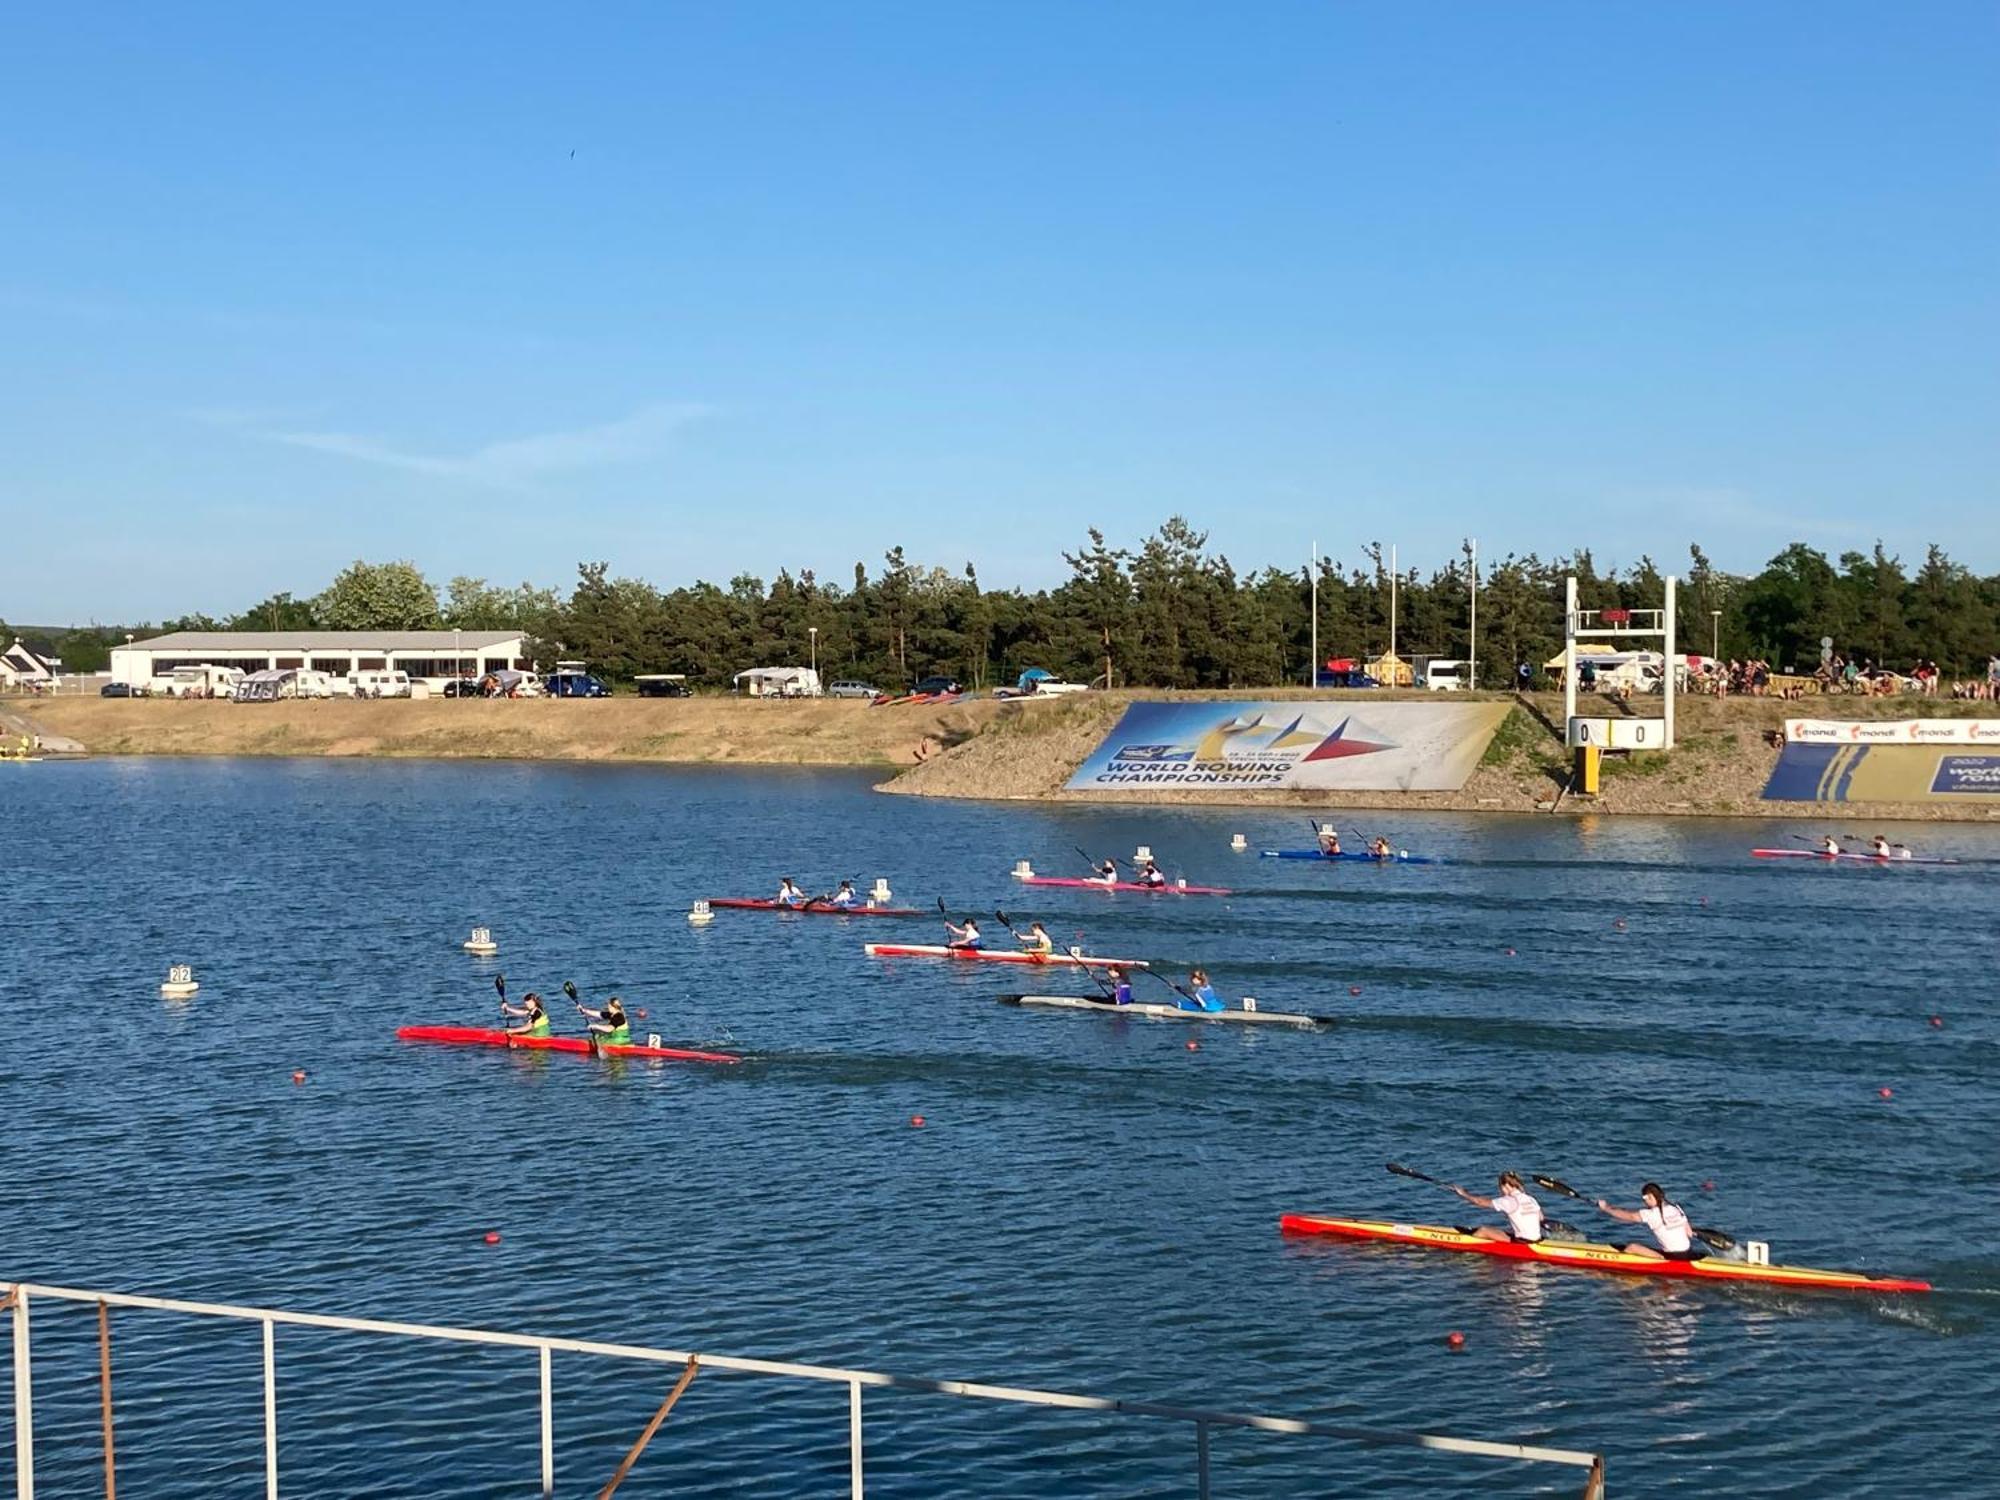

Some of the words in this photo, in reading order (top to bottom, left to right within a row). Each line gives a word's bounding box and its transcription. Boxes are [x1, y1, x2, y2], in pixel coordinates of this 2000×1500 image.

[1581, 724, 1589, 742] 0
[1636, 726, 1645, 743] 0
[1803, 729, 1837, 737] mondi
[1860, 729, 1895, 737] mondi
[1918, 729, 1954, 737] mondi
[1106, 763, 1186, 772] WORLD
[1193, 763, 1292, 772] ROWING
[1950, 767, 2000, 775] worl
[1096, 774, 1283, 783] CHAMPIONSHIPS
[1753, 1245, 1761, 1262] 1
